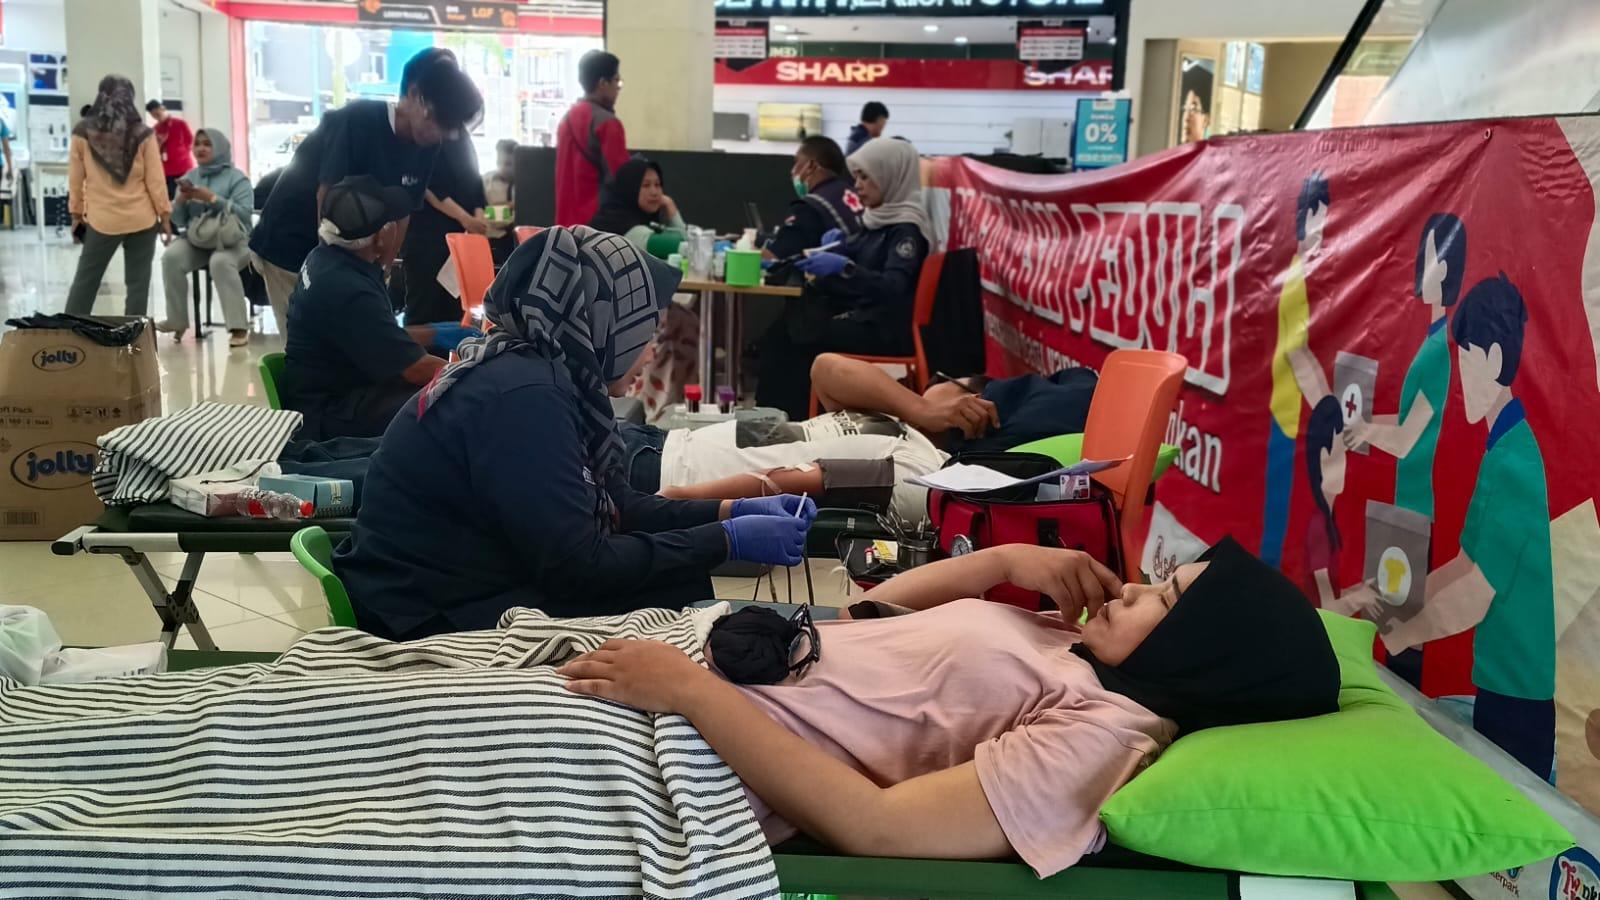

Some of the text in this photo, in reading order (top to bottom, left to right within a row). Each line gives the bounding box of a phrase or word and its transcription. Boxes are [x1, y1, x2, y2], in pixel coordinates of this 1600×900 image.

[776, 61, 889, 82] SHARP
[1085, 123, 1117, 143] 0%
[41, 350, 77, 367] jolly
[27, 450, 94, 482] jolly
